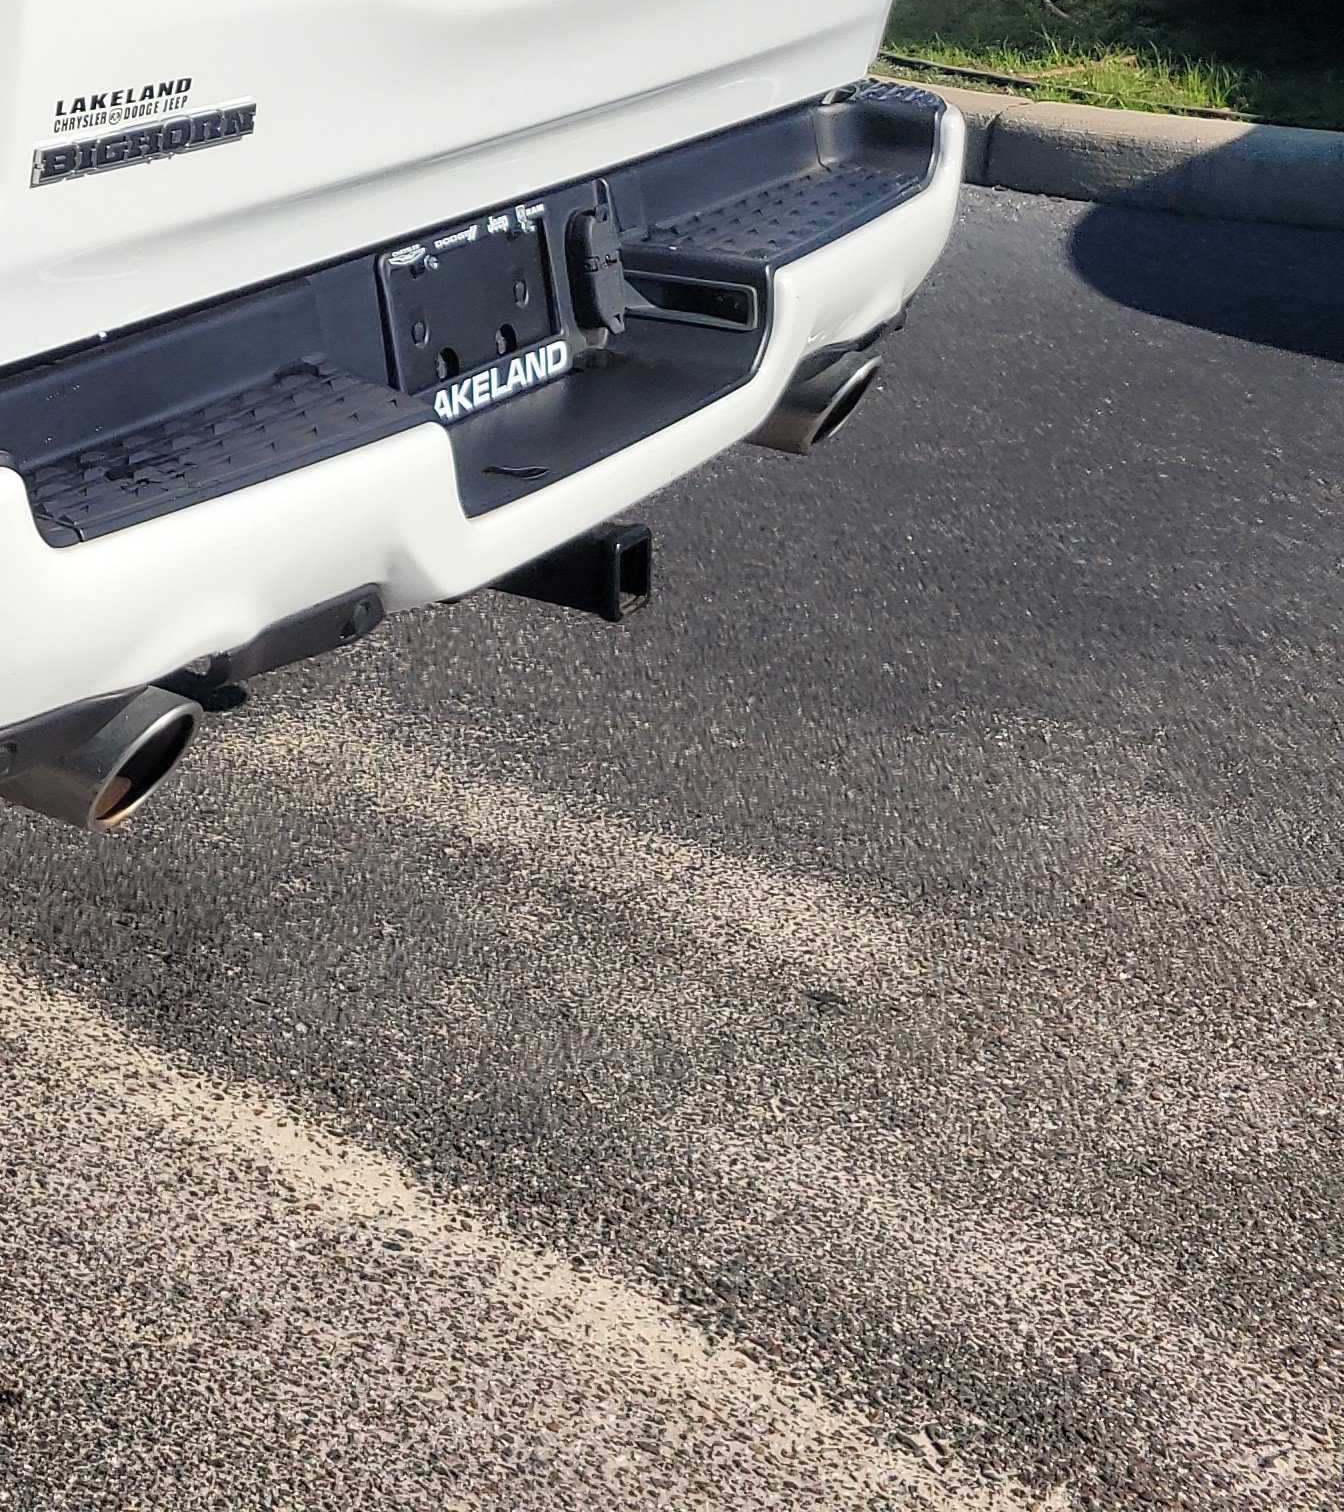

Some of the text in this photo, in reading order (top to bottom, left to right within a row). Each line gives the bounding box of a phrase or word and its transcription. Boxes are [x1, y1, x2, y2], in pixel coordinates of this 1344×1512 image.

[53, 95, 189, 134] CHRYSLER DODGE JEEP
[54, 77, 193, 117] LAKELAND
[433, 340, 568, 420] AKELAND
